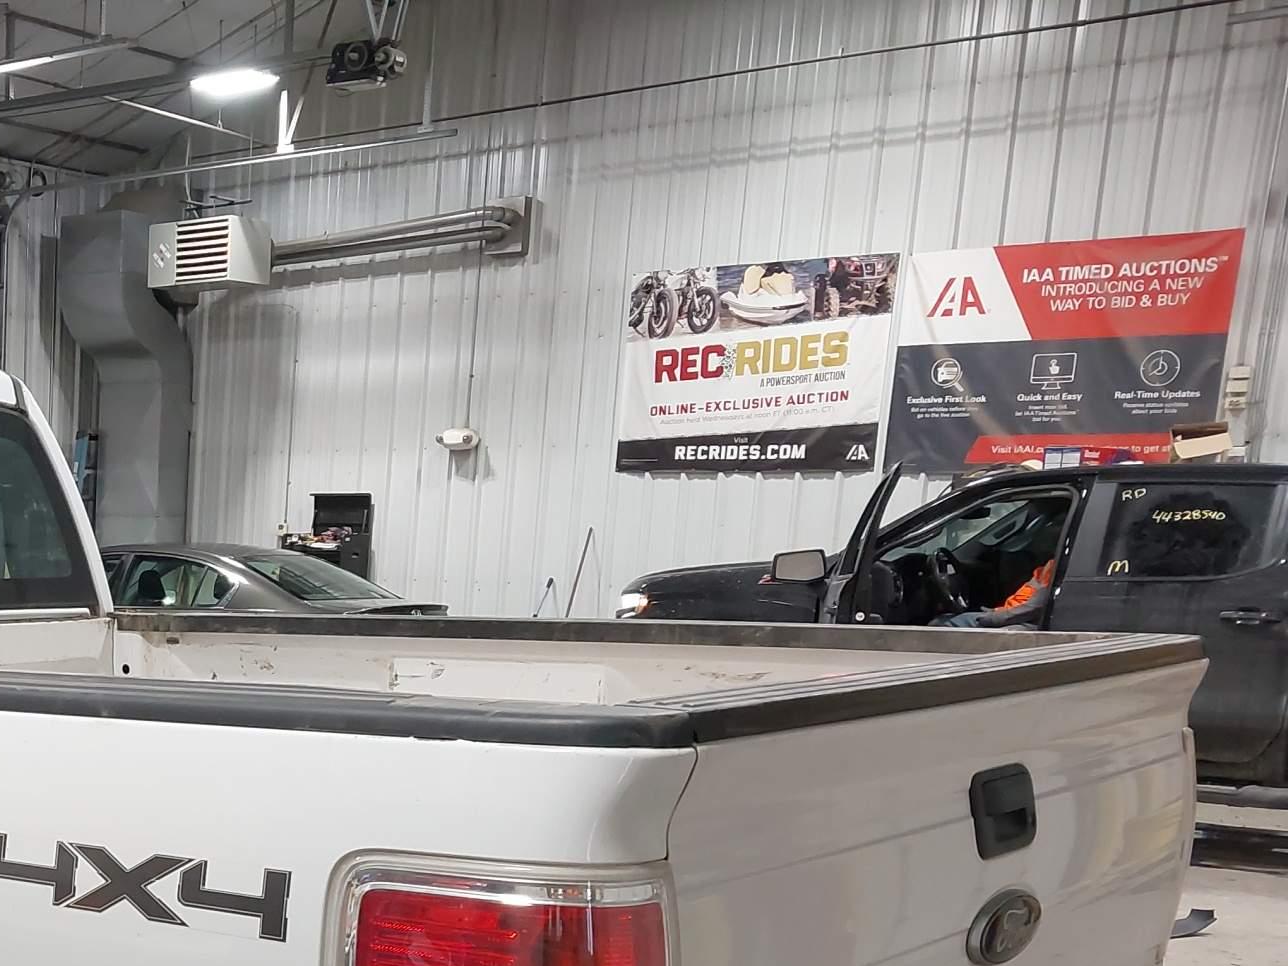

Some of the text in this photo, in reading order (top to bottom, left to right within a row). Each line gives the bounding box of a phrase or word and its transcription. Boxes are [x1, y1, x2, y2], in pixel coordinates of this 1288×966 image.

[1022, 268, 1054, 283] IAA
[1059, 264, 1113, 281] TIMED
[1041, 276, 1205, 297] INTRODUCING A NEW
[1050, 292, 1192, 312] WAY TO BID & BUY
[655, 331, 849, 384] REC RIDES
[766, 373, 812, 388] POWERSPORT
[814, 370, 846, 383] AUCTION
[649, 389, 850, 417] ONLINE-EXCLUSIVE AUCTION
[907, 395, 987, 404] Exclusive First Look
[1016, 392, 1083, 402] Quick and Easy
[1114, 390, 1201, 400] Real-Time Updates
[734, 436, 749, 444] Visit
[674, 444, 807, 460] RECRIDES.COM
[991, 445, 1012, 454] Visit
[1152, 509, 1226, 523] 44328540
